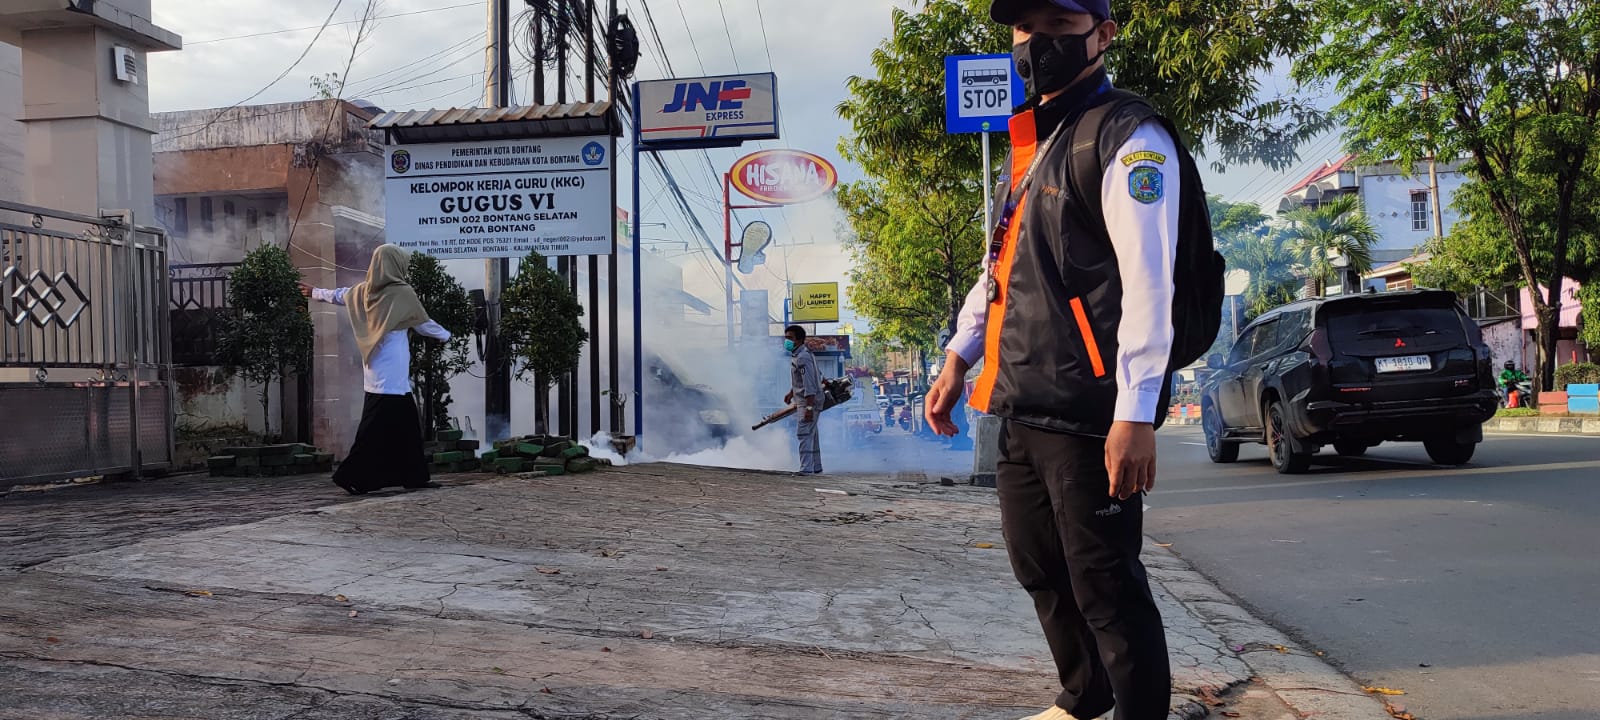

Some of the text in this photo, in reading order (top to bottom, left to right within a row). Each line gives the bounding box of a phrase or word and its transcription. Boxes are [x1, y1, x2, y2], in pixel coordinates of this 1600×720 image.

[661, 80, 751, 113] JNE
[963, 89, 1007, 109] STOP
[706, 110, 744, 121] EXPRESS
[451, 145, 542, 157] PEMERINTAH KOTA BONTANG
[414, 155, 580, 170] DINAS PENDIDIKAN DAN KEBUDAYAAN KOTA BONTANG
[745, 161, 820, 187] HISANA
[410, 176, 584, 194] KELOMPOK KERJA GURU (KKG)
[440, 192, 555, 213] GUGUS VI
[418, 212, 578, 225] INTI SDN 002 BONTANG SELATAN
[459, 224, 536, 234] KOTA BONTANG
[427, 247, 453, 255] BONTANG
[483, 245, 508, 253] BONTANG
[514, 244, 549, 252] KALIMANTAN
[551, 243, 569, 251] TIMUR
[1377, 359, 1388, 367] KT
